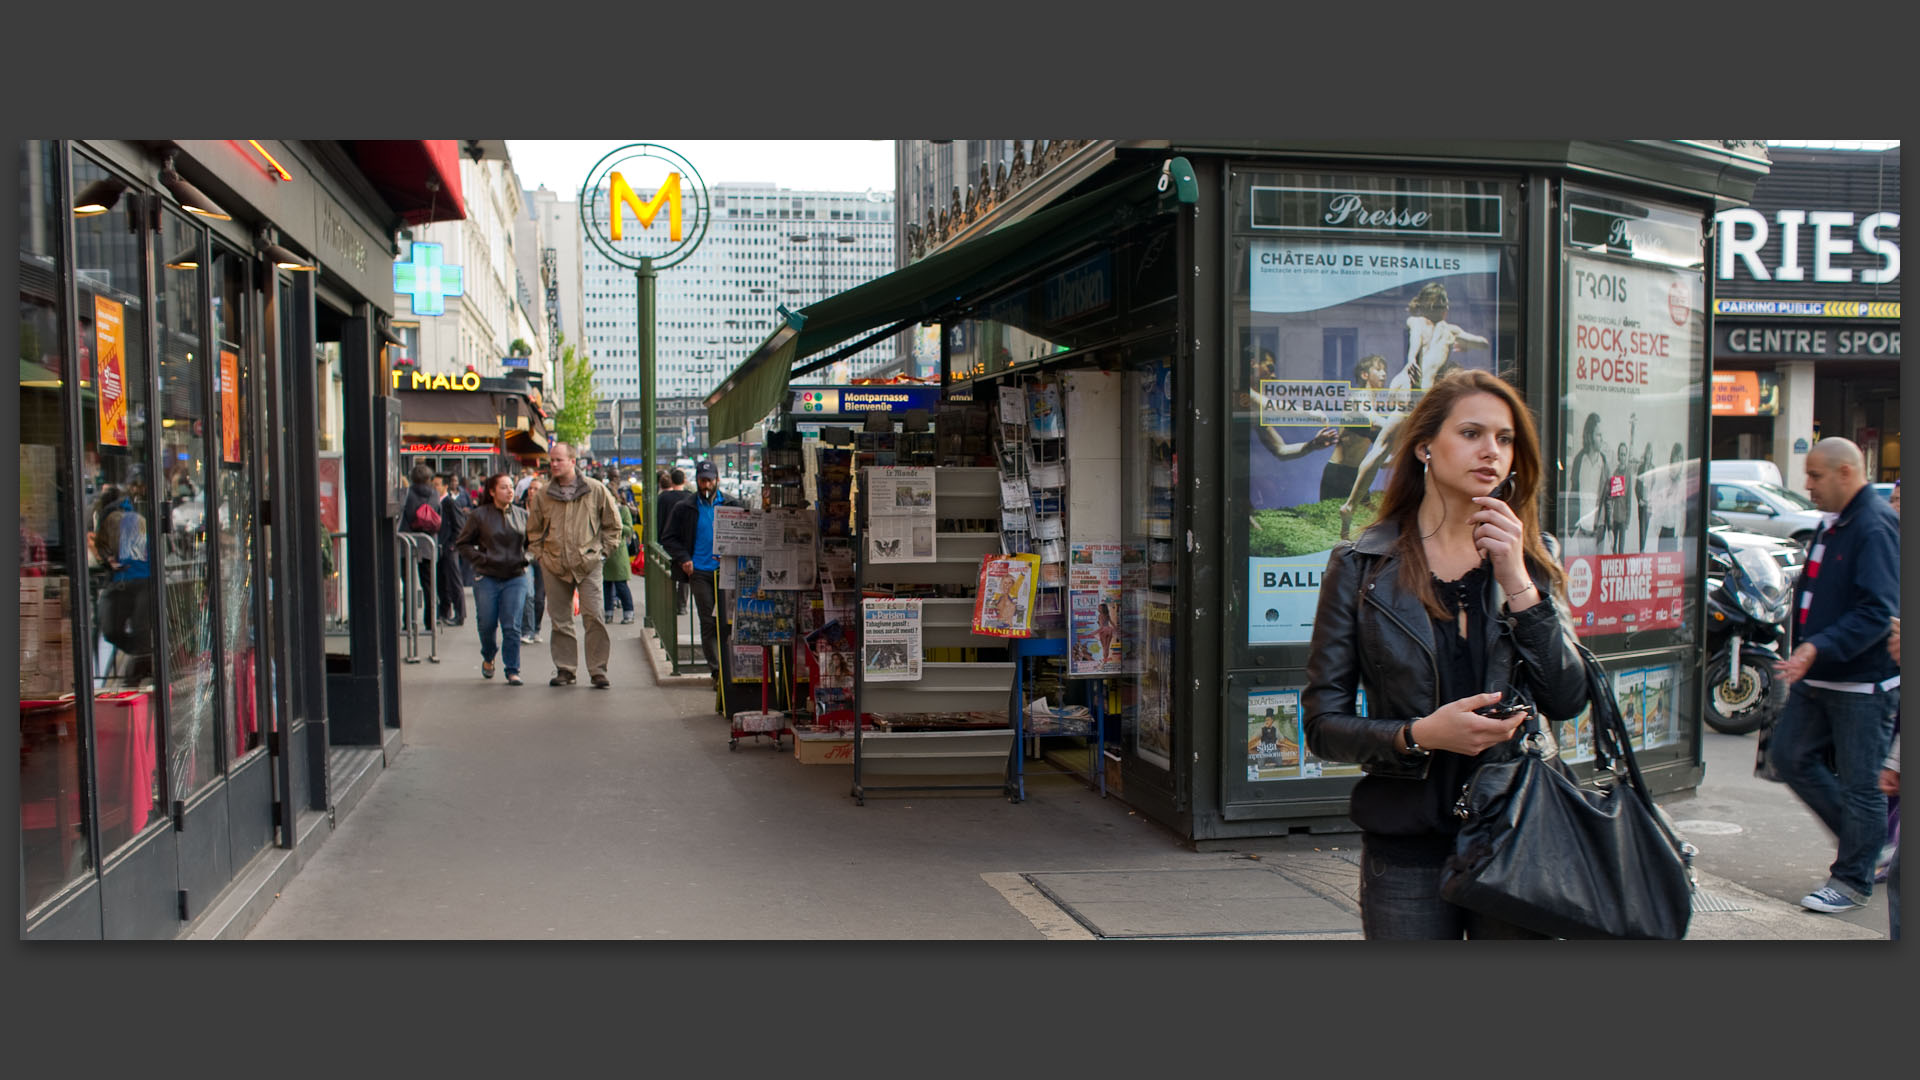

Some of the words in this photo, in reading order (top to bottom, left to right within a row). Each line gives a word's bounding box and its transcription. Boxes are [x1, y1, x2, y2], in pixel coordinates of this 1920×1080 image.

[610, 171, 682, 242] M
[1325, 194, 1433, 227] Presse
[1716, 208, 1900, 283] RIES
[1260, 250, 1337, 266] CHÂTEAU
[1342, 254, 1364, 267] DE
[1369, 255, 1461, 270] VERSAILLES
[1575, 270, 1627, 303] TROIS
[1721, 301, 1776, 313] PARKING
[1779, 302, 1823, 314] PUBLIC
[1859, 304, 1868, 315] P
[1577, 324, 1627, 357] ROCK,
[1630, 331, 1669, 357] SEXE
[1729, 329, 1827, 353] CENTRE
[1838, 331, 1900, 353] SPOR
[1576, 355, 1587, 380] &
[1590, 354, 1648, 384] POÉSIE
[412, 370, 481, 391] MALO
[845, 393, 909, 402] Montparnasse
[1264, 384, 1345, 397] HOMMAGE
[845, 402, 892, 411] Bienvenüe
[1264, 399, 1297, 411] AUX
[1303, 400, 1372, 412] BALLETS
[1376, 400, 1415, 412] RUSS
[410, 444, 470, 452] BRASSERIE
[1600, 558, 1625, 576] WHEN
[1626, 557, 1653, 575] YOU'RE
[1263, 571, 1327, 588] BALL
[1600, 576, 1652, 603] STRANGE
[865, 620, 891, 629] Tabagisme
[892, 620, 907, 628] passif
